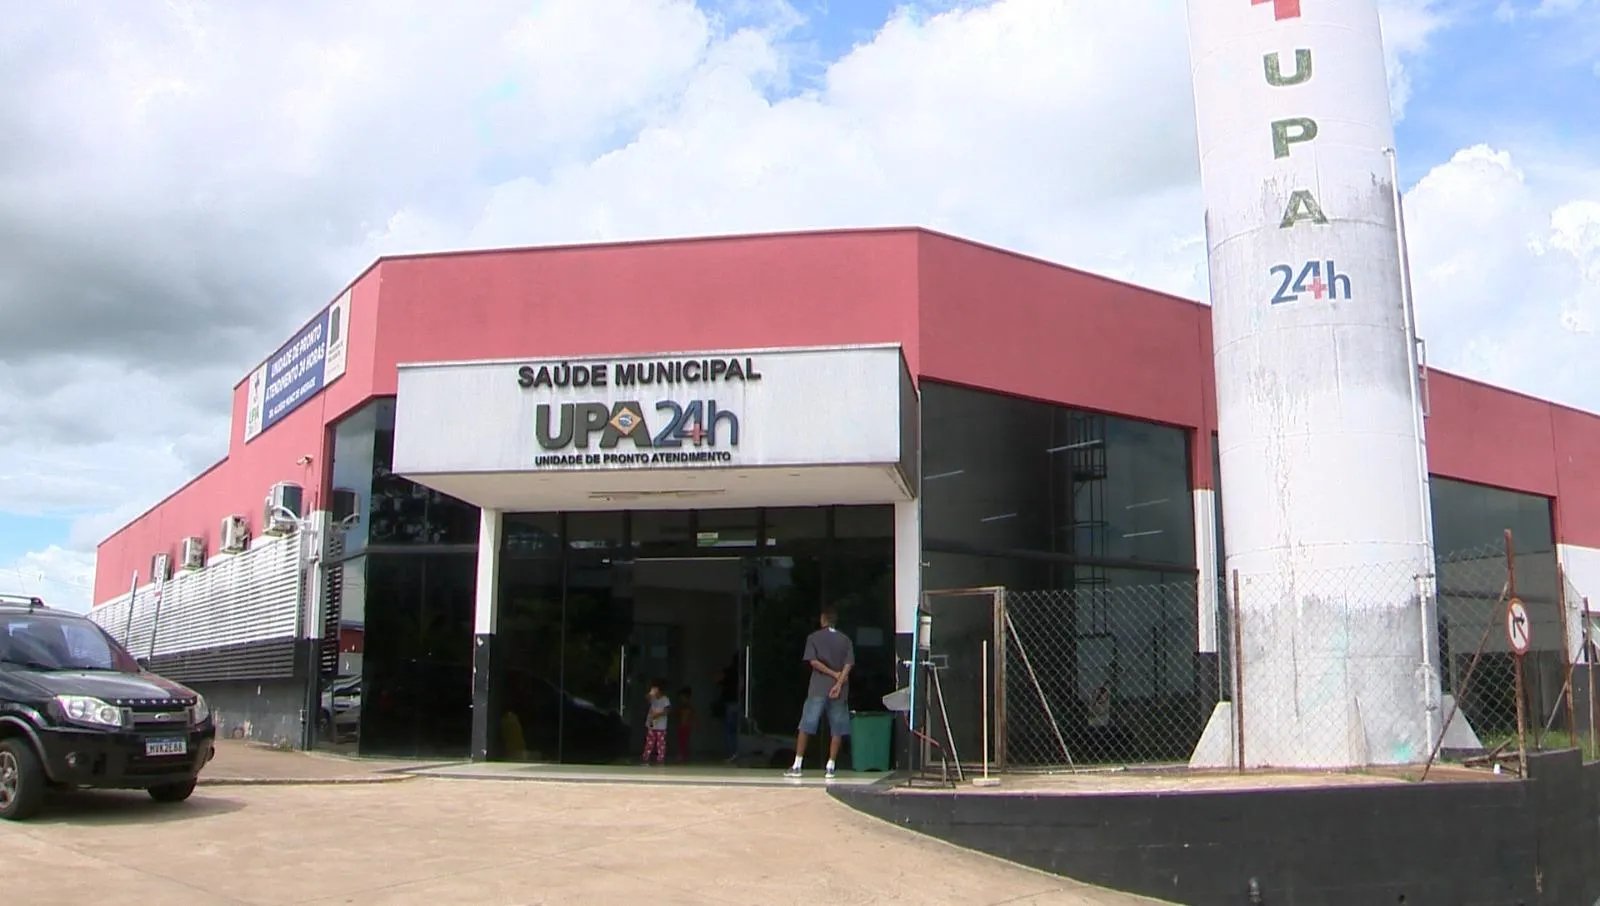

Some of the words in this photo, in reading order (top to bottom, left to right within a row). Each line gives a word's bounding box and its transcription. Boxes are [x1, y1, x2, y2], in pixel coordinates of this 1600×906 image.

[1263, 48, 1329, 229] UPA
[1269, 260, 1352, 305] 24h
[292, 341, 300, 361] DE
[300, 323, 322, 353] PRONTO
[265, 363, 298, 402] ATENDIMENTO
[305, 342, 325, 371] HORAS
[517, 361, 608, 388] SAÚDE
[615, 358, 762, 386] MUNICIPAL
[535, 400, 652, 450] UPA
[653, 399, 739, 447] 24h
[535, 454, 584, 466] UNIDADE
[585, 453, 600, 465] DE
[603, 452, 650, 464] PRONTO
[651, 451, 732, 464] ATENDIMENTO
